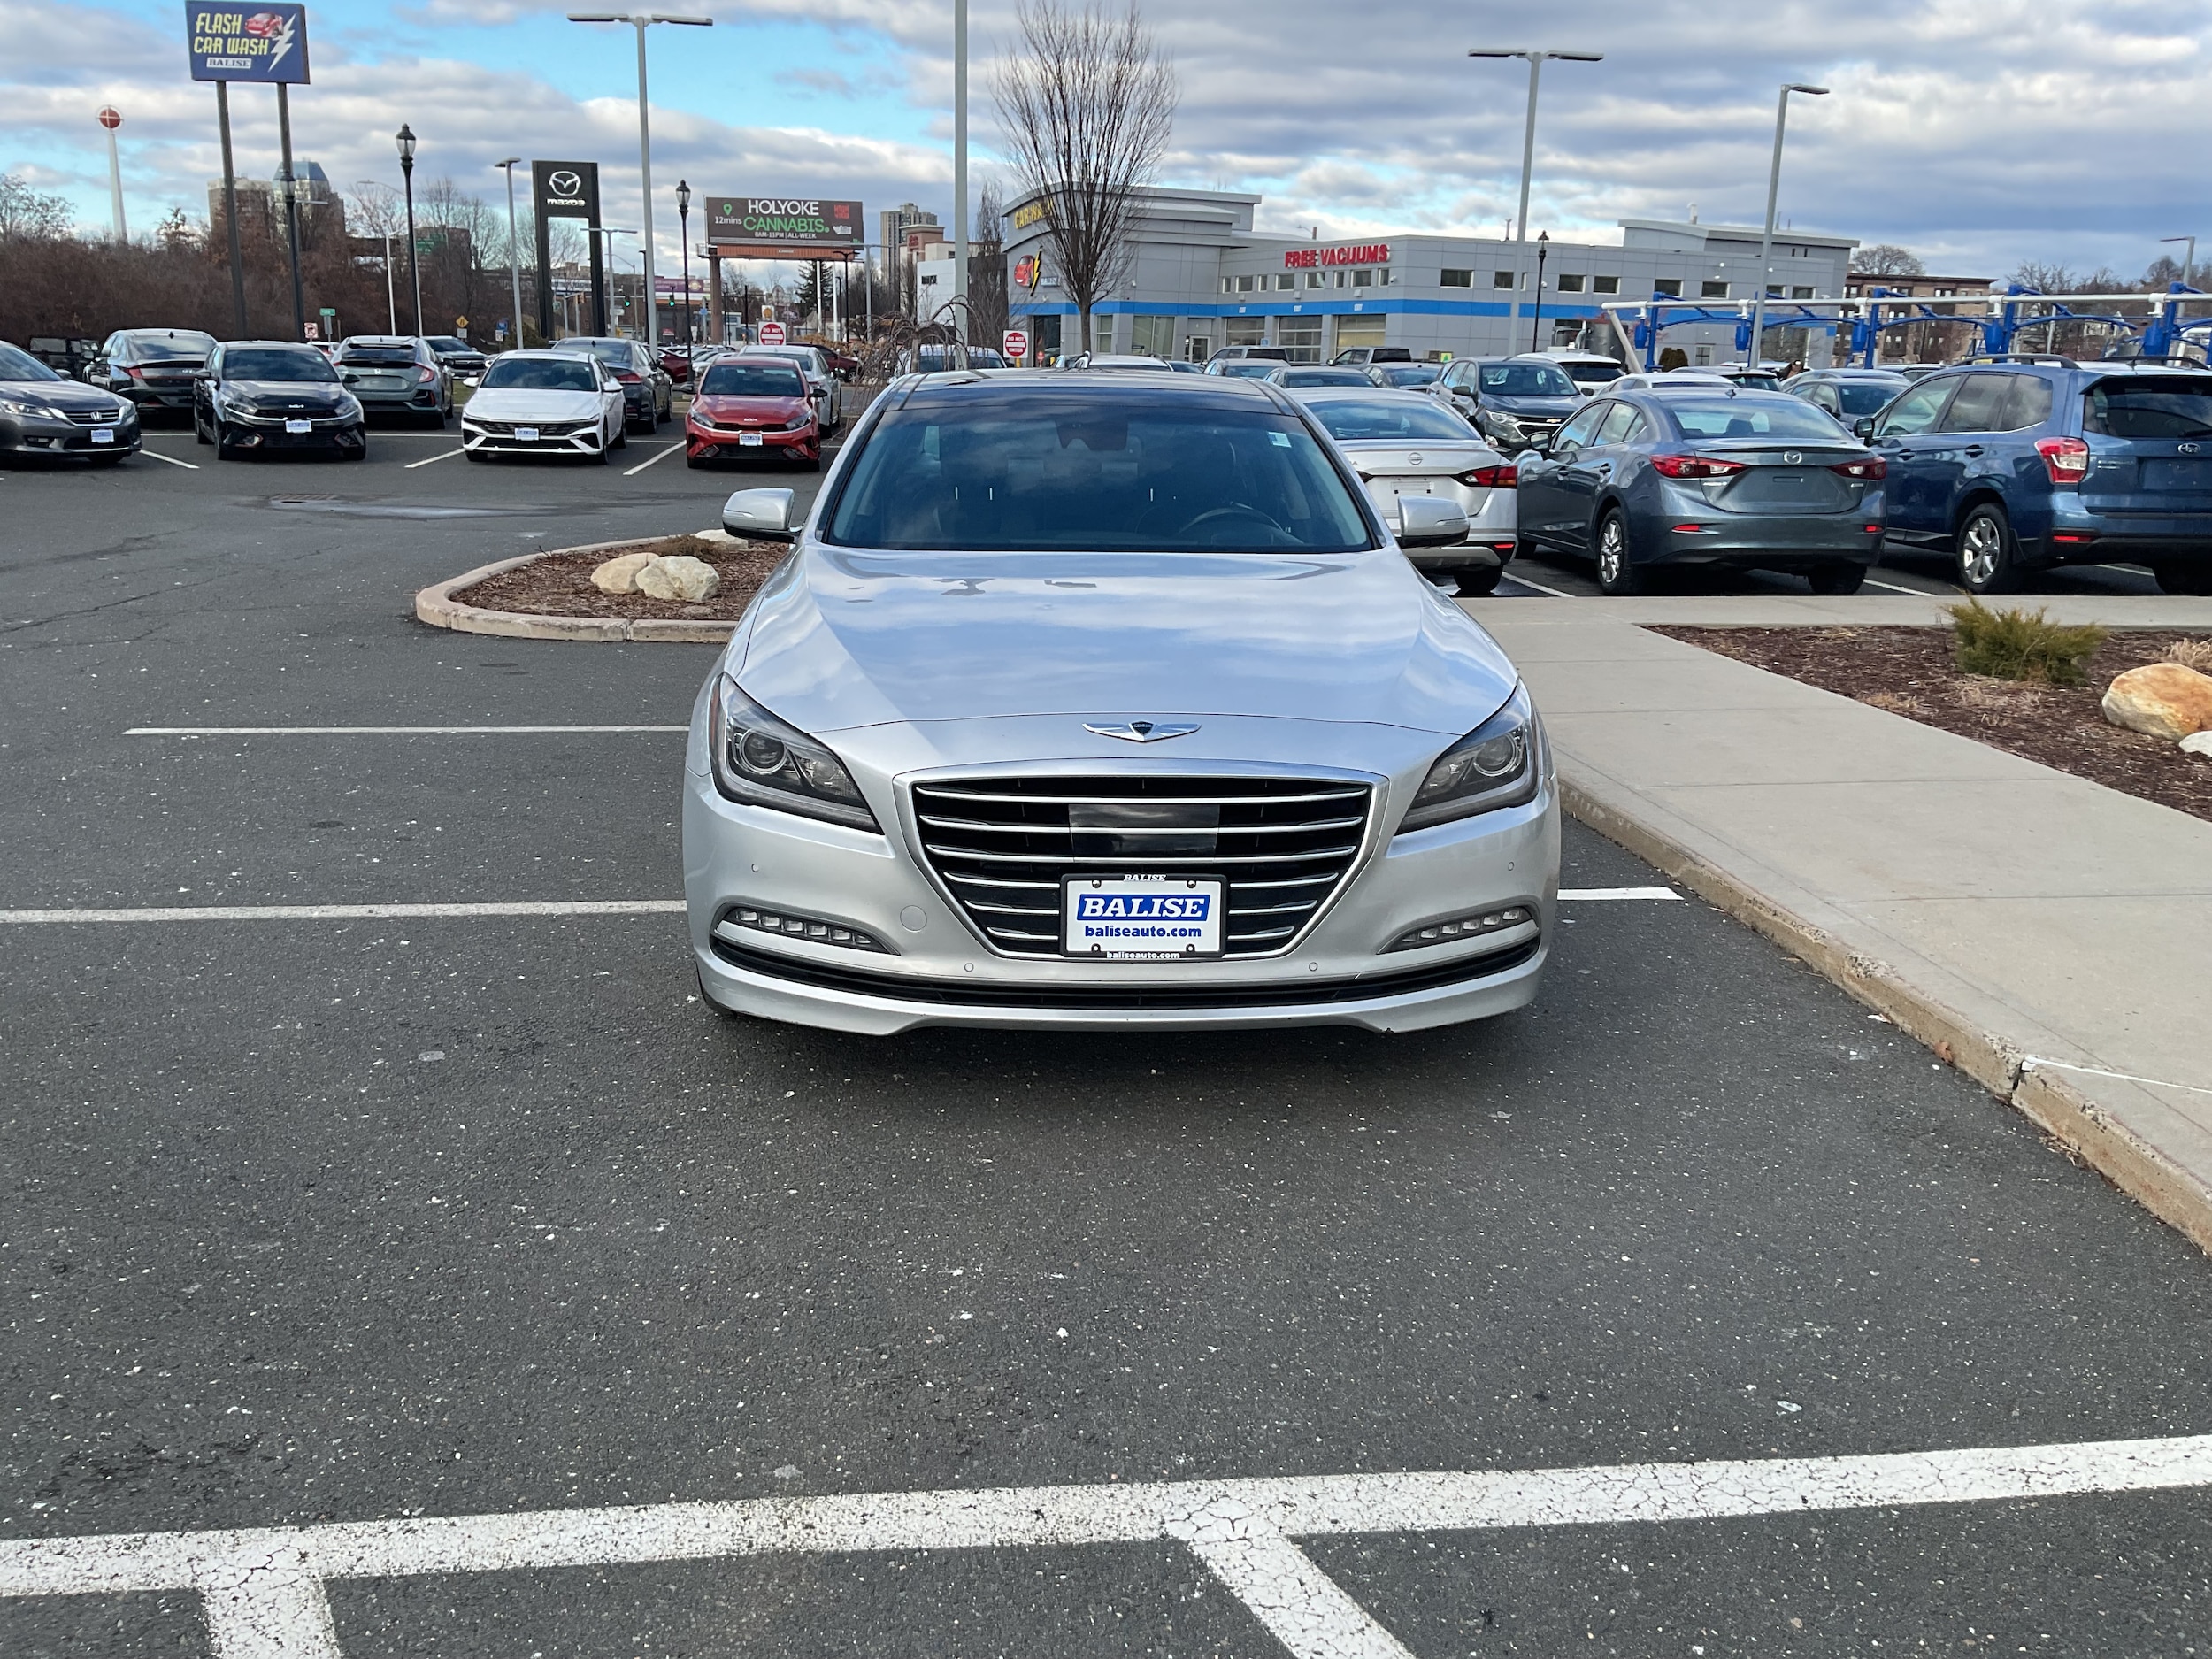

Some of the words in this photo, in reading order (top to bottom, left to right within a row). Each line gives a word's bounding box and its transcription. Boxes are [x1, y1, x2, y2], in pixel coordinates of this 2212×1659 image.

[196, 12, 242, 35] FLASH
[194, 36, 223, 54] CAR
[226, 37, 269, 56] WASH
[209, 58, 250, 67] BALISE
[546, 198, 586, 207] mazda
[748, 199, 819, 216] HOLYOKE
[715, 216, 742, 225] 12mins
[1285, 250, 1317, 268] FREE
[1320, 243, 1389, 265] VACUUMS
[1082, 897, 1206, 918] BALISE
[1085, 926, 1202, 937] baliseauto.com
